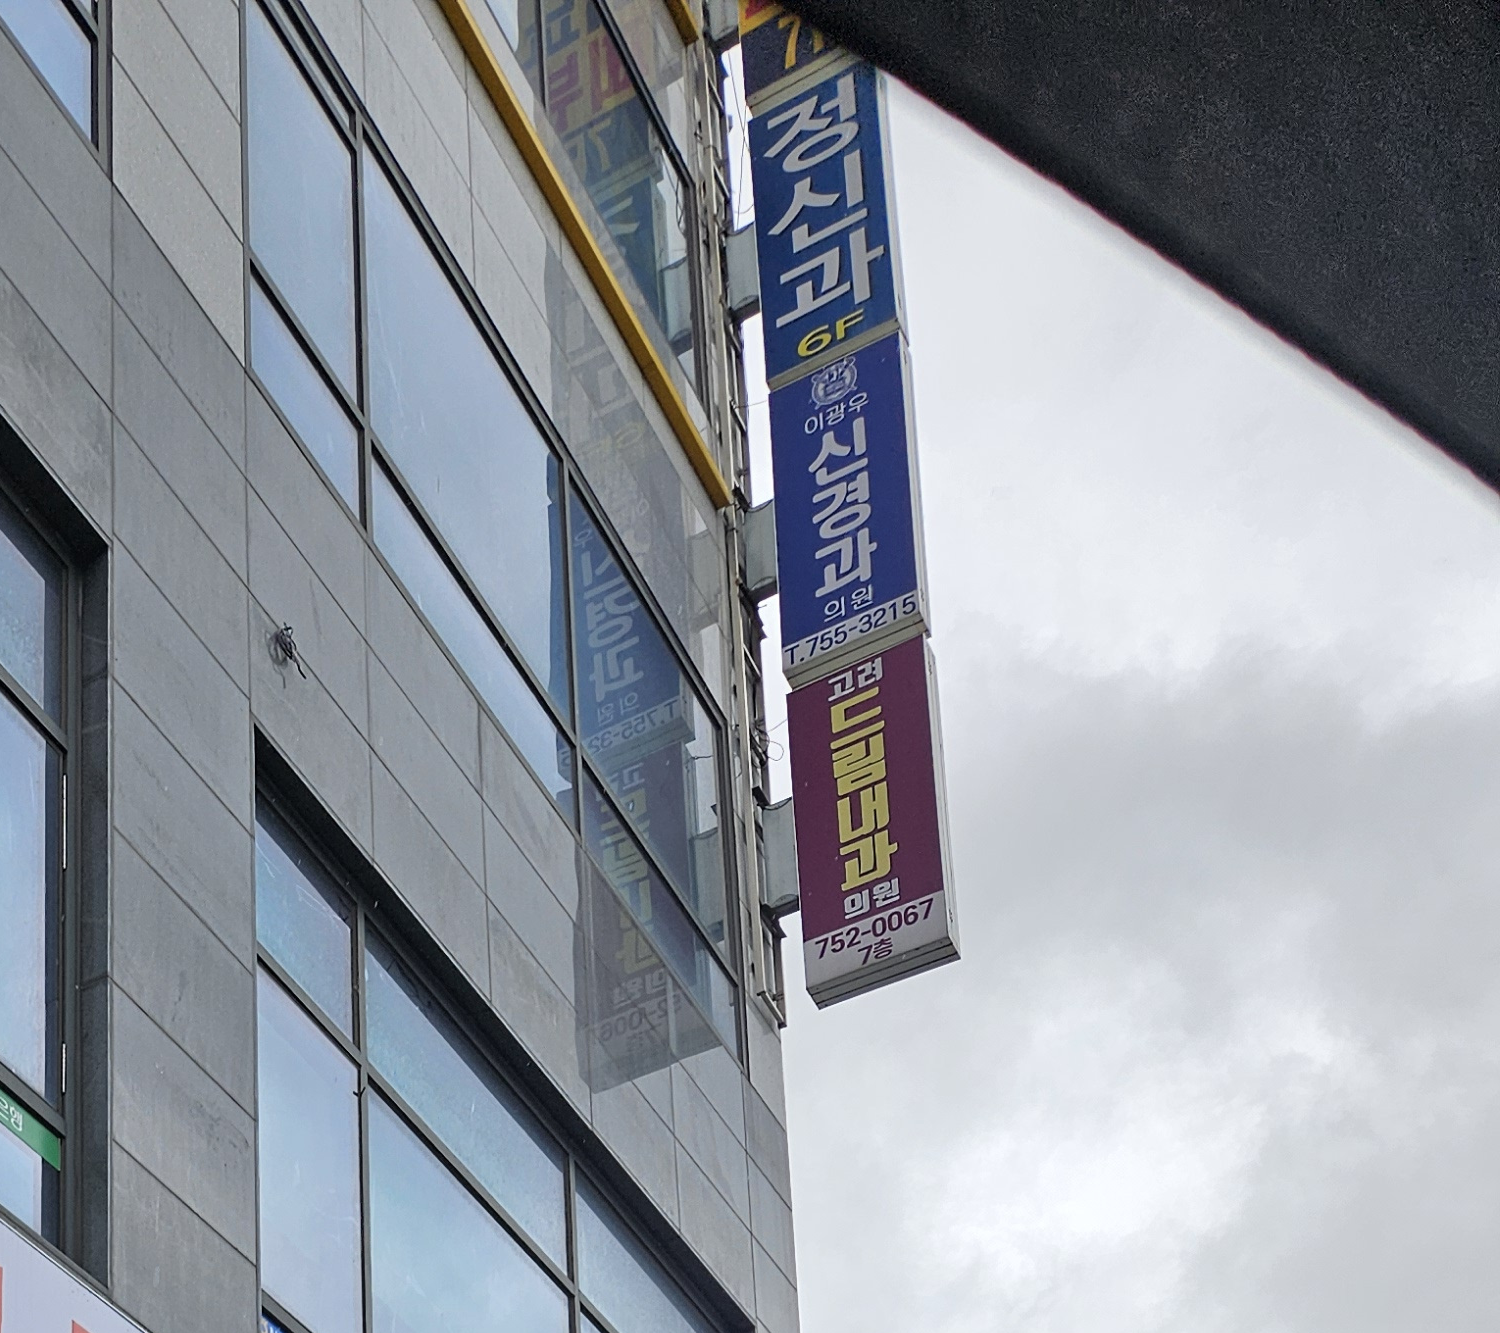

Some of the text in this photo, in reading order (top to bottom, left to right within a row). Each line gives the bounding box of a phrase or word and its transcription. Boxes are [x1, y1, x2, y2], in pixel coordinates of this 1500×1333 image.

[764, 72, 884, 328] 정신과
[798, 309, 864, 357] 6F
[804, 392, 869, 434] 이광우
[808, 416, 877, 598] 신경과
[823, 584, 874, 622] 의원
[783, 597, 917, 667] T.755-3215
[827, 656, 883, 702] 고려
[830, 685, 898, 892] 드림내과
[843, 877, 900, 921] 의원
[815, 898, 935, 960] 752-0067
[858, 937, 894, 966] 7층
